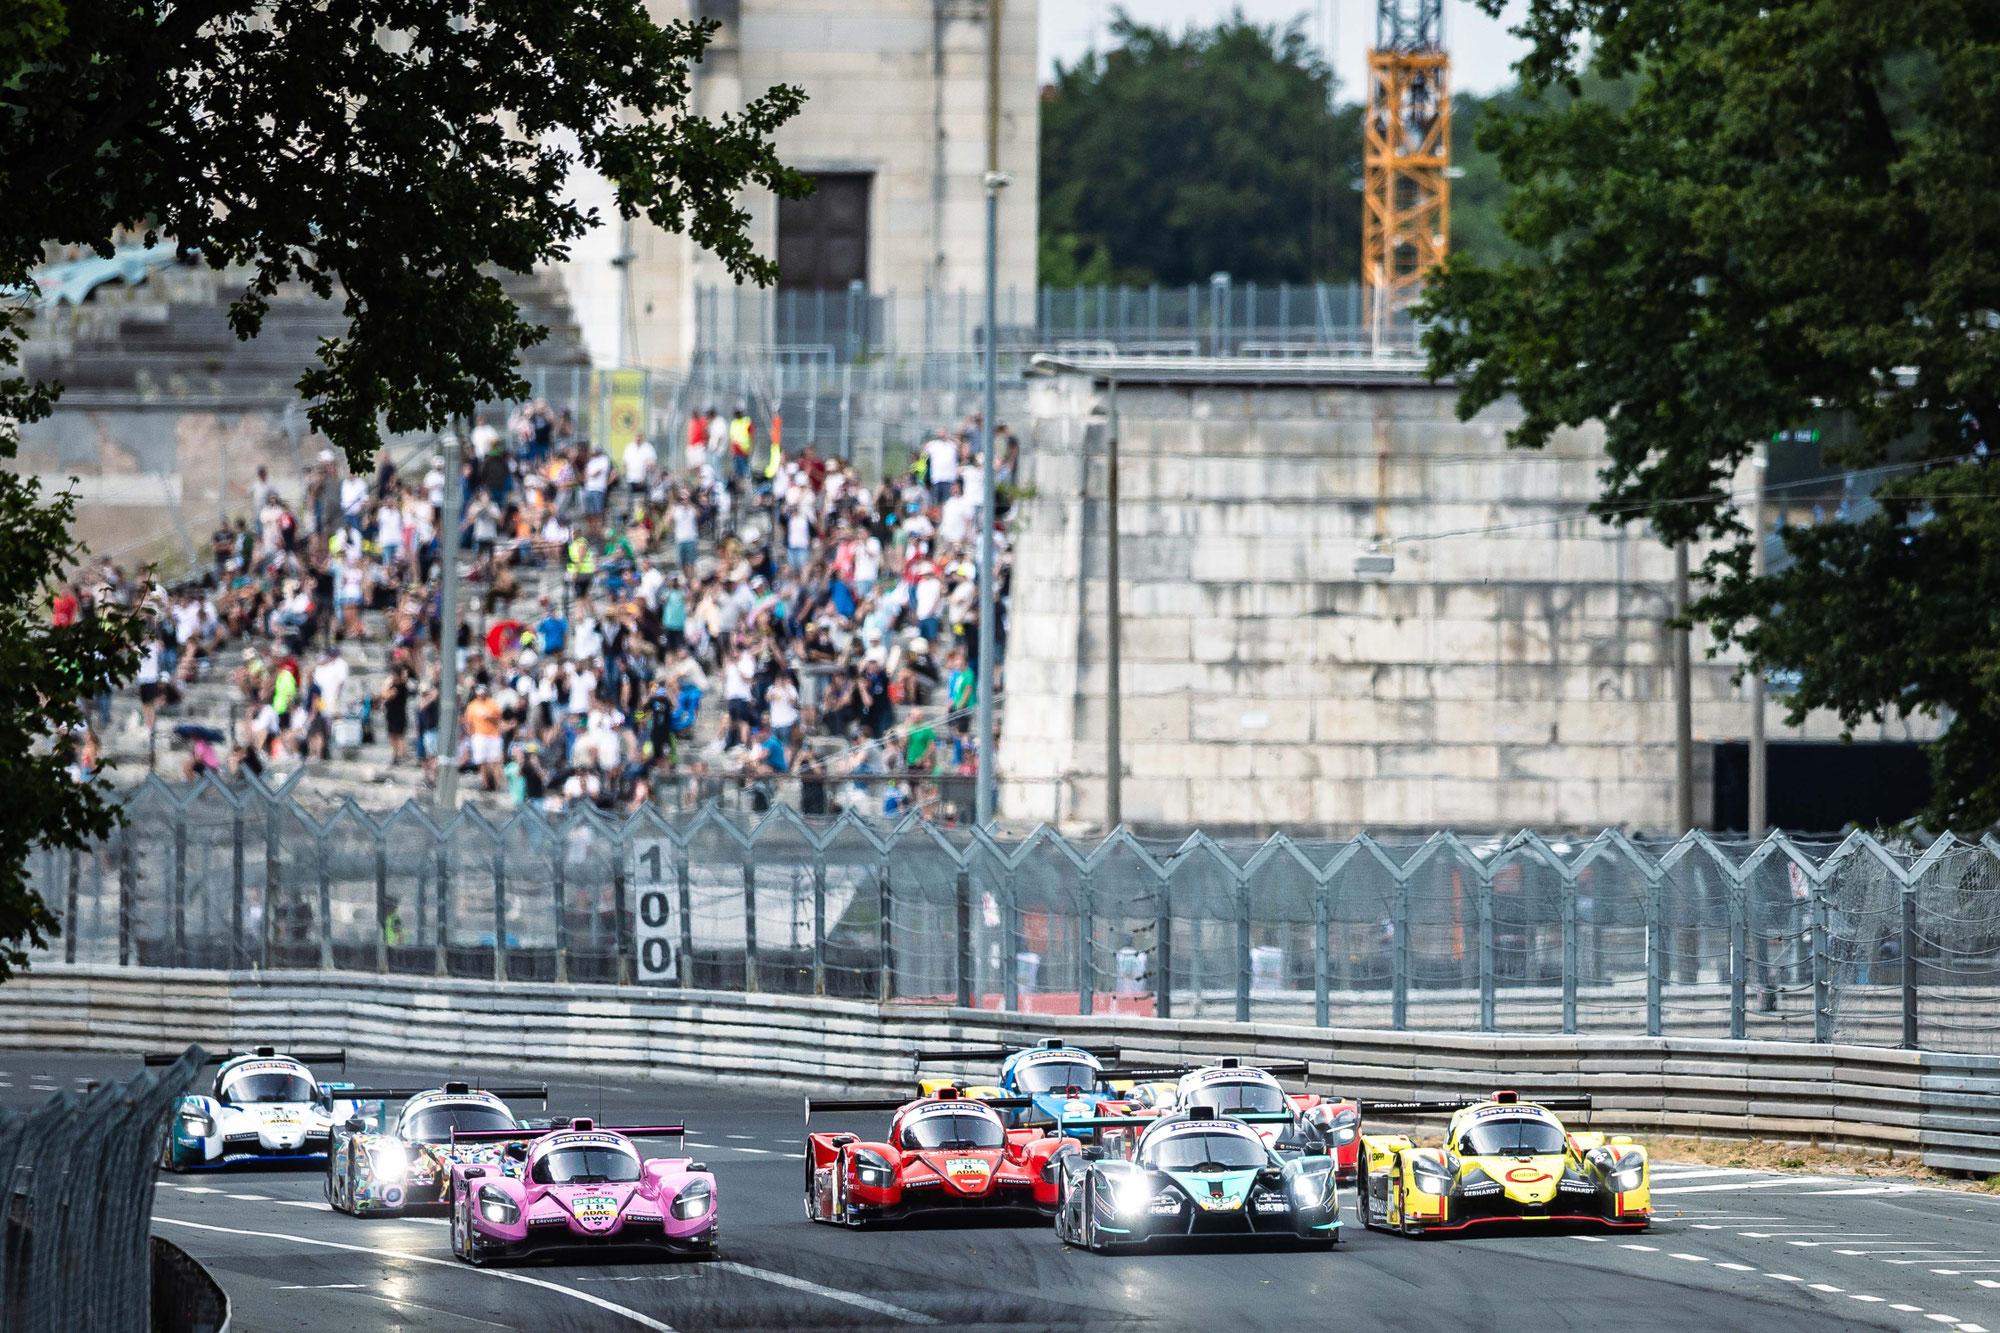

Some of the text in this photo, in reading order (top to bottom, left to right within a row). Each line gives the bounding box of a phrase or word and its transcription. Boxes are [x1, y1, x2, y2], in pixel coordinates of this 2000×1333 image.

[640, 845, 671, 973] 100
[1480, 1107, 1538, 1116] RAVENOL
[1464, 1188, 1500, 1197] GEBHARDT
[1560, 1186, 1595, 1194] GEBHARDT
